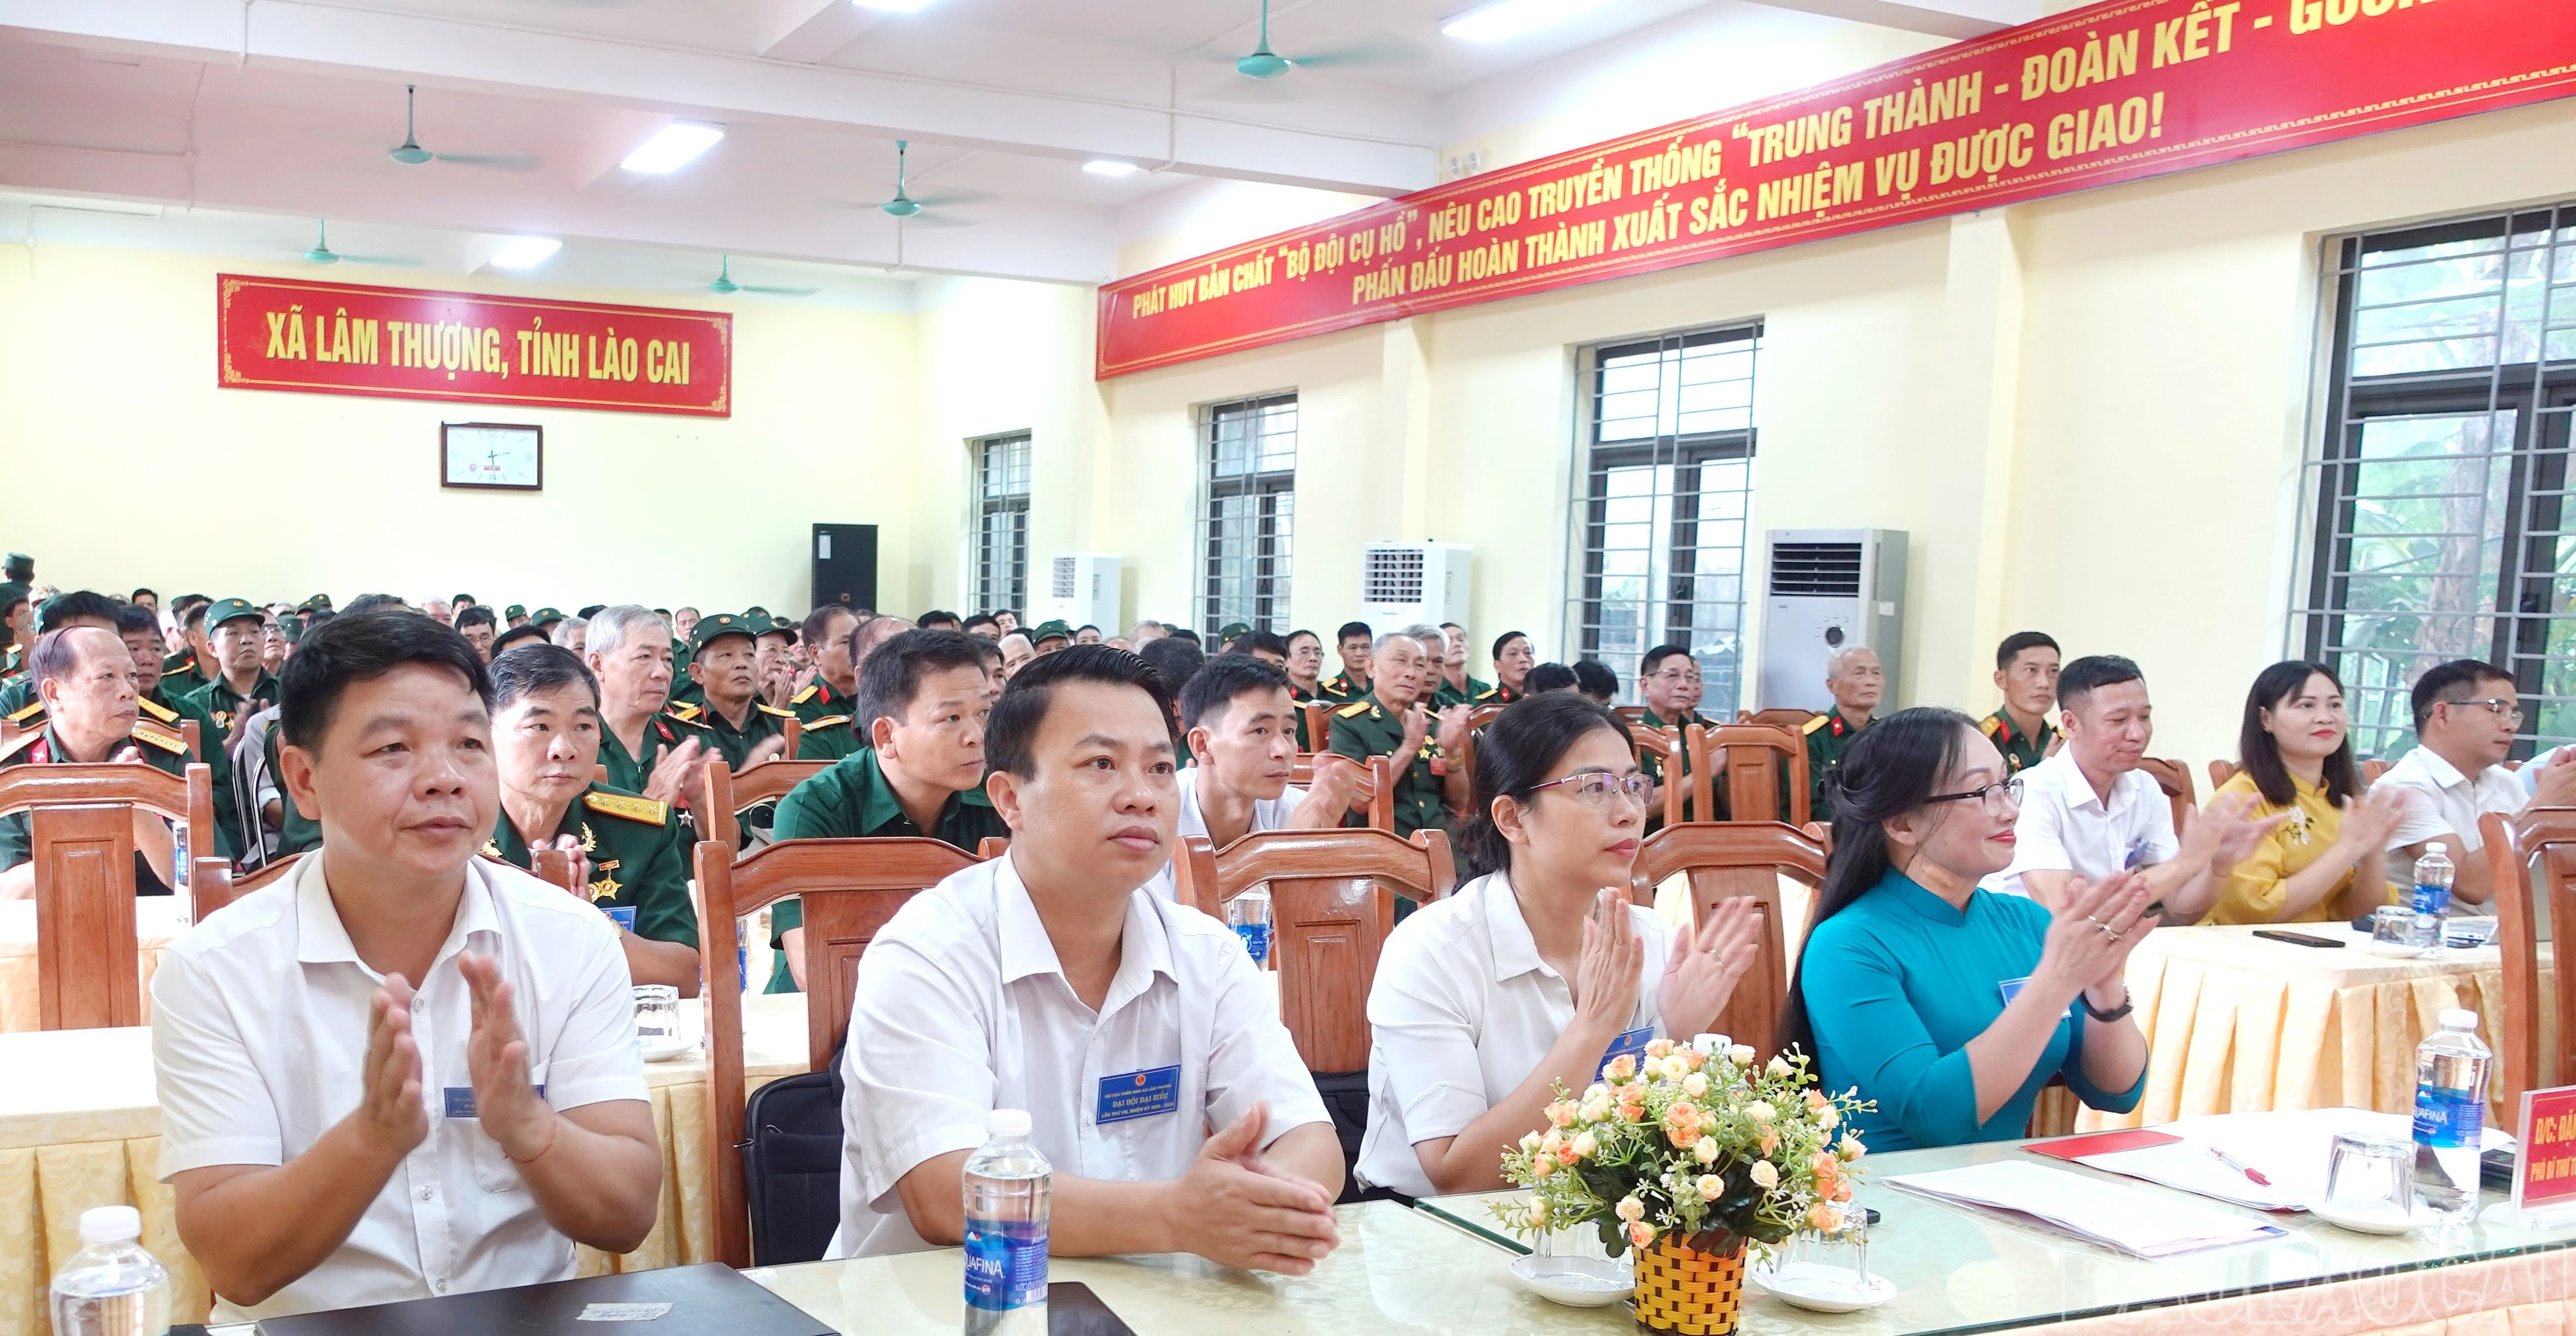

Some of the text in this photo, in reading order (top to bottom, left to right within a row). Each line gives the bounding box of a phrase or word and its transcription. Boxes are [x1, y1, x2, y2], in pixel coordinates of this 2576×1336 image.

[1132, 283, 1168, 319] PHÁT
[1168, 277, 1197, 310] HUY
[1198, 263, 1230, 302] BẢN
[1232, 248, 1276, 294] CHẤT
[1278, 241, 1311, 282] “BỘ
[1313, 232, 1345, 274] ĐỘI
[1349, 230, 1375, 266] CỤ
[1428, 201, 1472, 244] NÊU
[1477, 191, 1523, 232] CAO
[1528, 157, 1624, 220] TRUYỀN
[1629, 136, 1723, 194] THỐNG
[1863, 71, 1983, 139] THÀNH
[2020, 29, 2139, 101] ĐOÀN
[1352, 91, 2165, 305] PHẤN ĐẤU HOÀN THÀNH XUẤT SẮC NHIỆM VỤ ĐƯỢC GIAO!
[265, 303, 691, 386] XÃ LÂM THƯỢNG, TỈNH LÀO CAI
